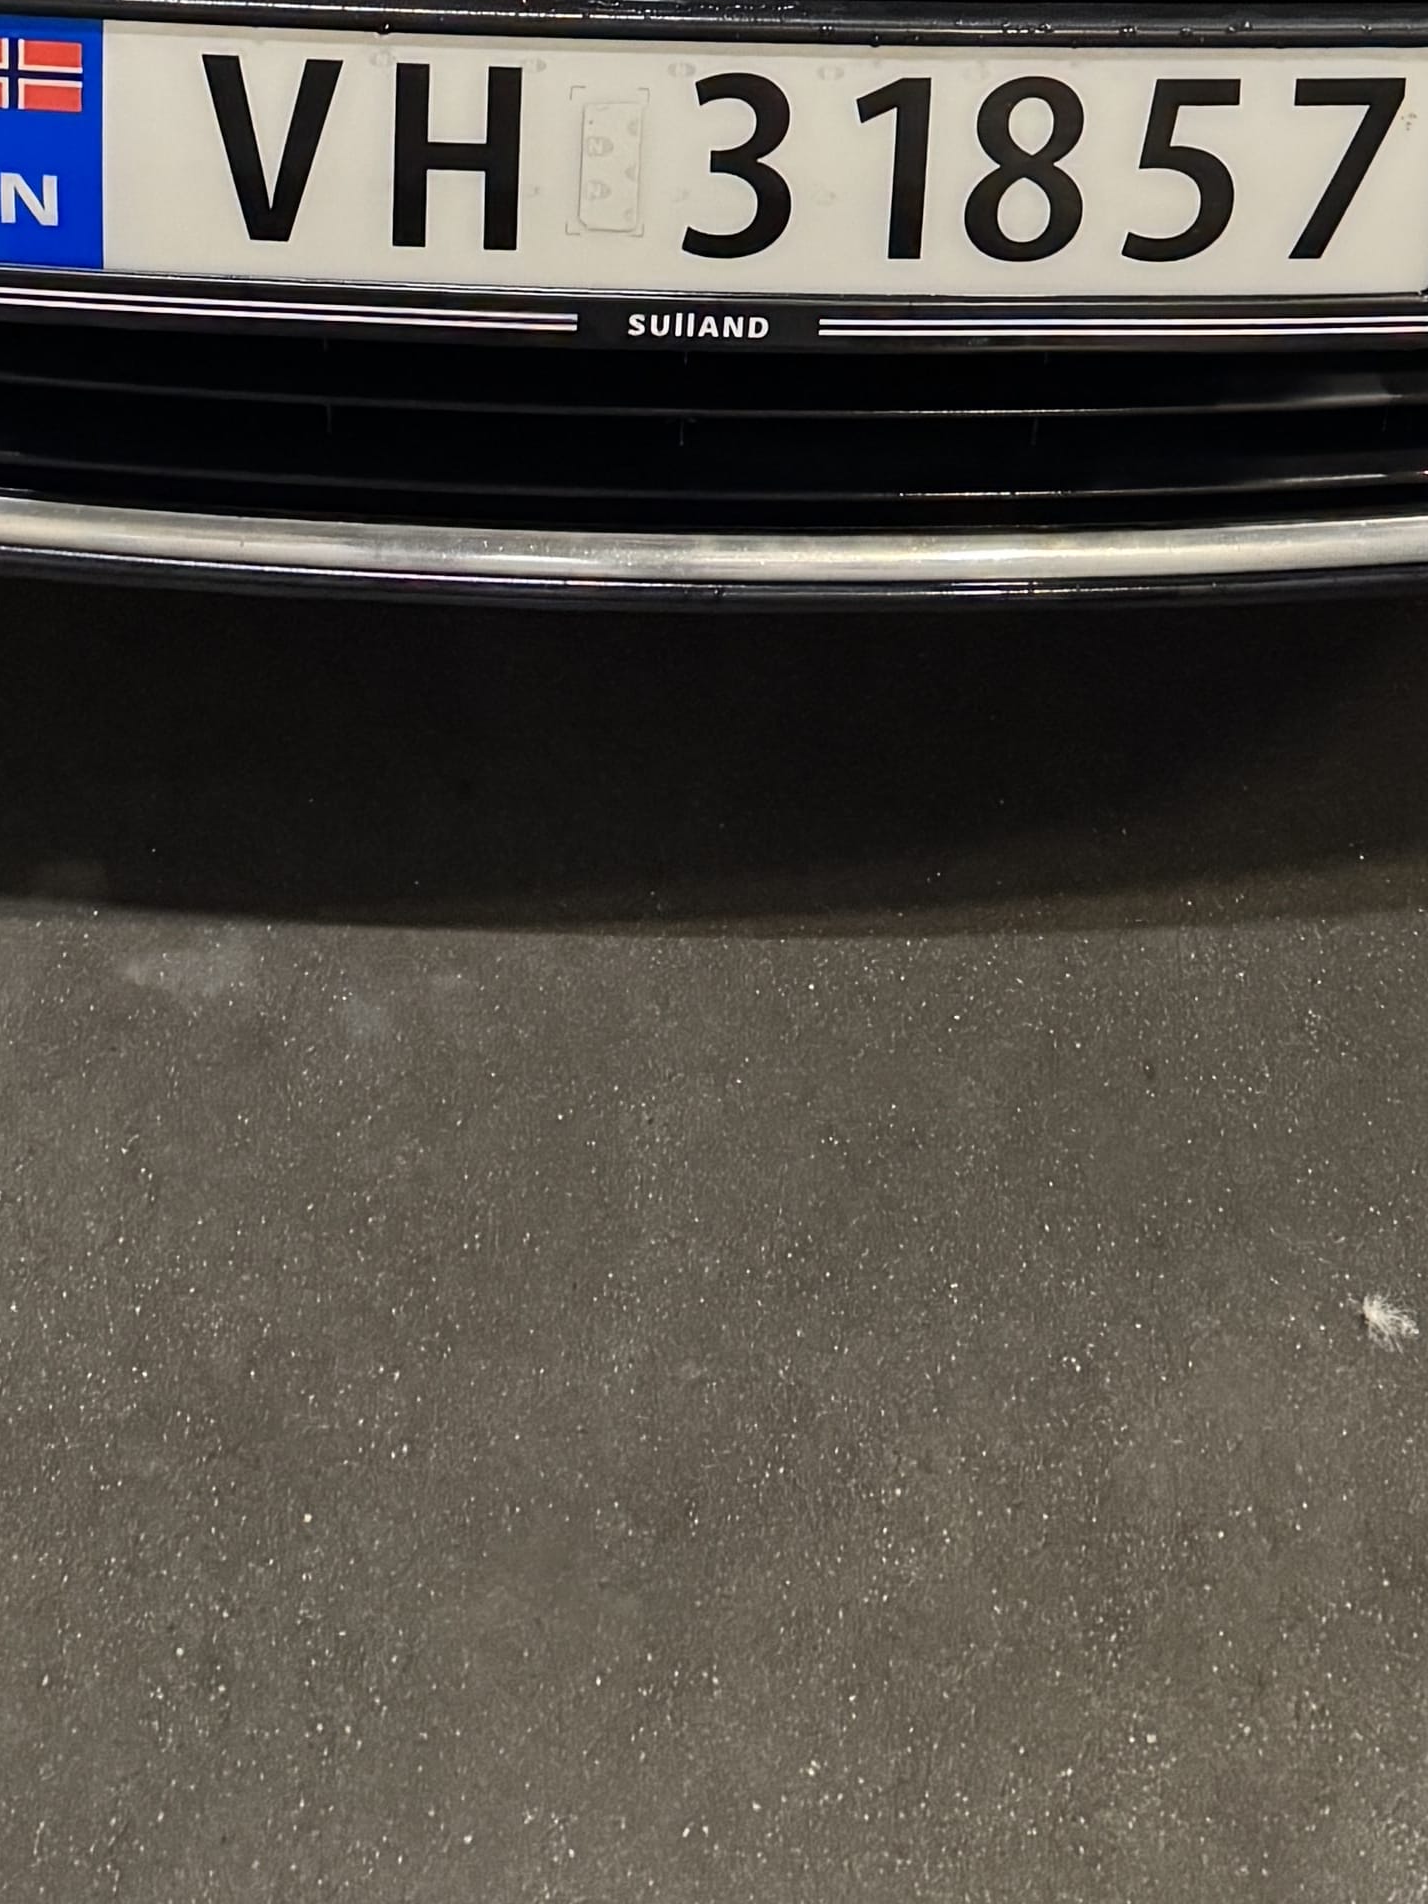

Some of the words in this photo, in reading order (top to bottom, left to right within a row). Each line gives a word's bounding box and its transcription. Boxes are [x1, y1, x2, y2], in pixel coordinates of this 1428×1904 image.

[0, 171, 59, 227] N
[201, 52, 524, 252] VH
[680, 72, 1408, 264] 31857
